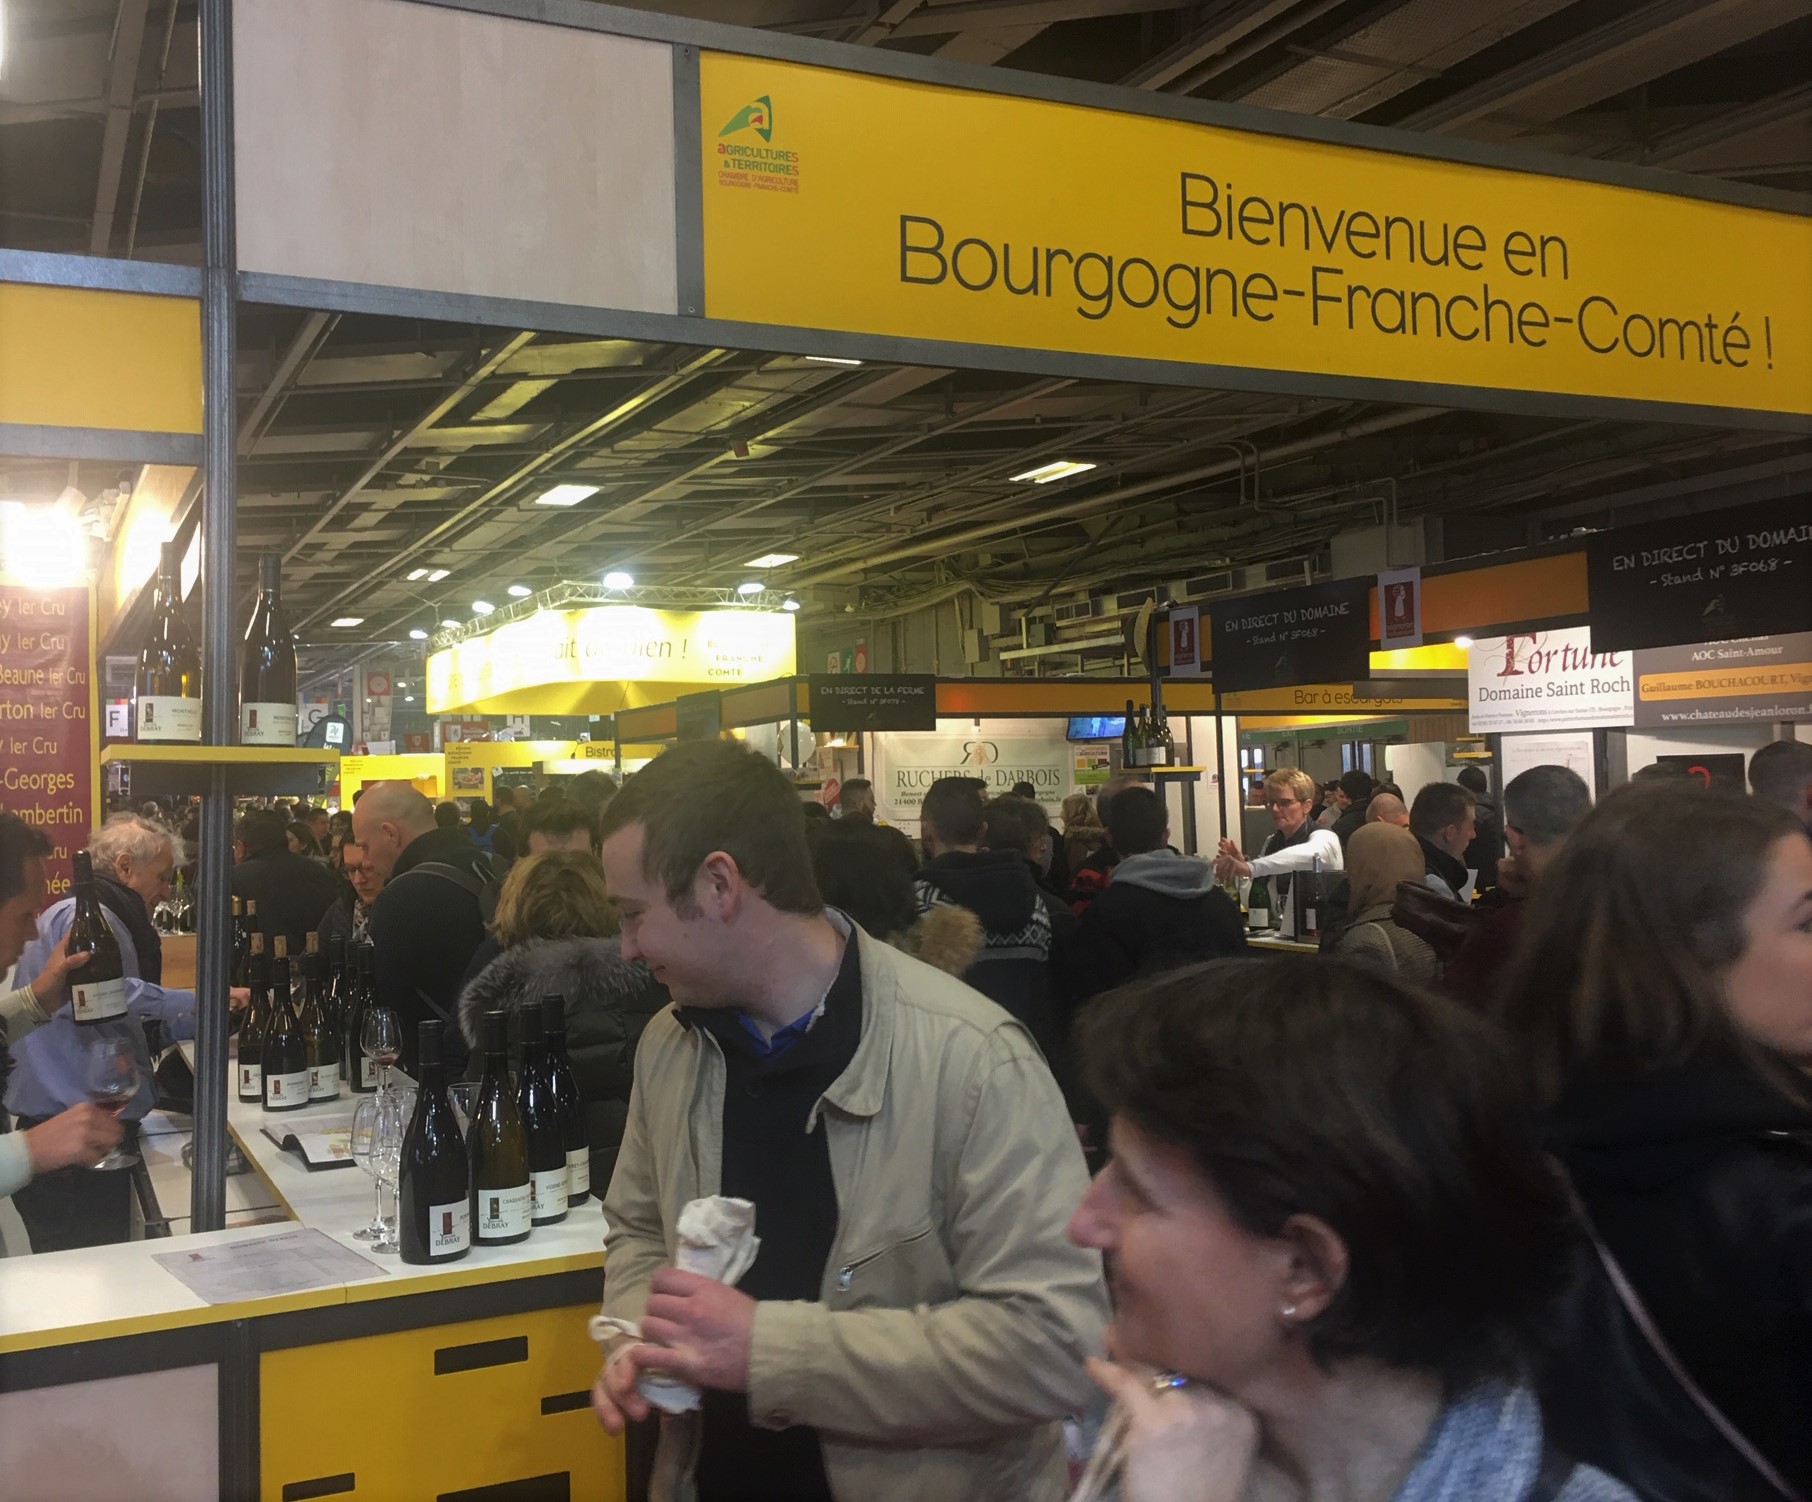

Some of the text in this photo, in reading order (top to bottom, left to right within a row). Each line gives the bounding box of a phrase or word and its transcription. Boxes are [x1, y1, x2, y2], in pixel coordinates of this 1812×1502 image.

[731, 158, 799, 176] TERRITOIRES
[1181, 172, 1568, 279] Bienvenue en
[900, 214, 1751, 369] Bourgogne-Franche-Comté
[1613, 524, 1812, 571] EN DIRECT DU DOMAI
[1661, 568, 1704, 587] Stand
[1730, 557, 1780, 576] 3F068
[40, 598, 65, 616] Cru
[1225, 602, 1349, 632] EN DIRECT DU DOMAINE
[40, 632, 65, 650] Cru
[1253, 632, 1276, 646] Stand
[1692, 646, 1784, 661] AOC Saint-Amour
[67, 667, 86, 685] Cru
[821, 686, 925, 695] EN DIRECT DE LA FERME
[1479, 676, 1631, 702] Domaine Saint Roch
[1641, 682, 1694, 693] Guillaume
[1295, 690, 1319, 704] Bar
[1322, 690, 1333, 704] à
[62, 702, 86, 719] Cru
[109, 710, 120, 727] F
[308, 709, 323, 725] G
[33, 737, 57, 754] Cru
[996, 769, 1060, 787] DARBOIS
[894, 798, 916, 806] 21400
[48, 847, 67, 860] ru
[482, 1222, 509, 1230] DEBRAY
[435, 1236, 460, 1246] DEBRAY
